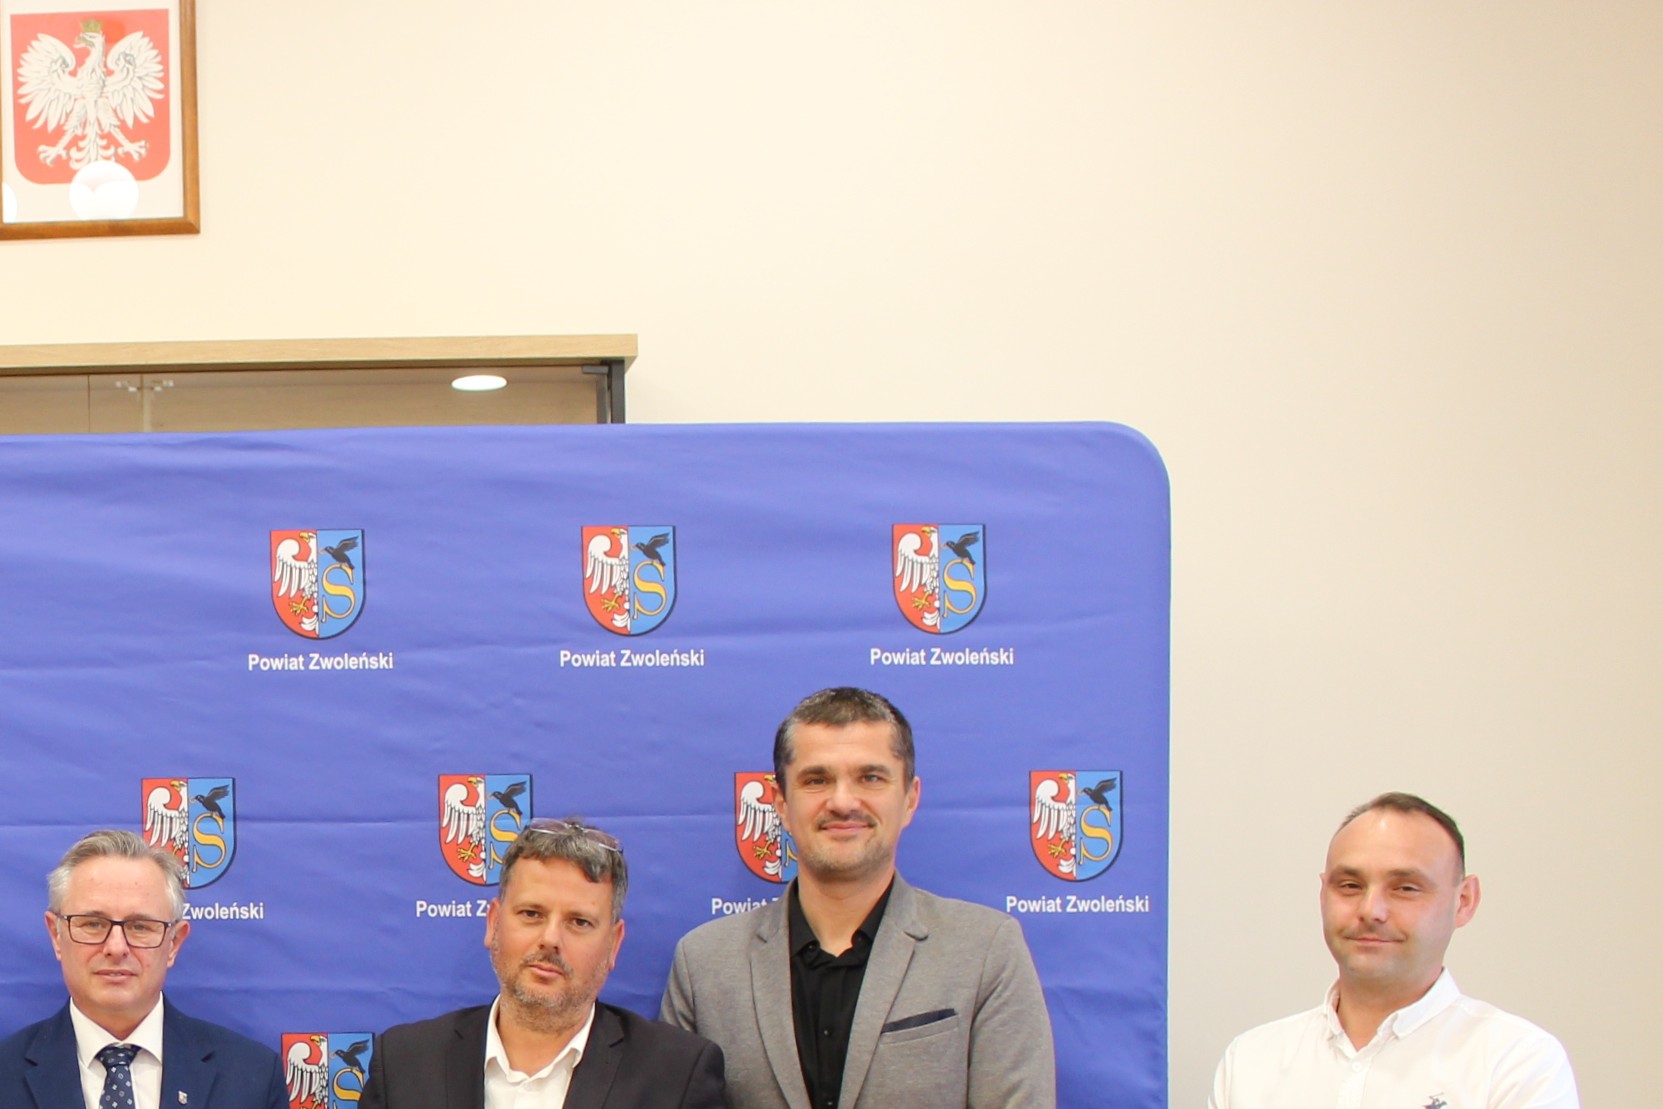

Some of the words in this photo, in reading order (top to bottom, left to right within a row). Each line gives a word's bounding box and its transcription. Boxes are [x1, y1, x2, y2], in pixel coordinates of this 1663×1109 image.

[248, 653, 305, 671] Powiat
[308, 652, 394, 670] Zwoleński
[560, 649, 617, 667] Powiat
[620, 649, 705, 667] Zwoleński
[870, 647, 927, 665] Powiat
[930, 647, 1014, 665] Zwoleński
[182, 902, 264, 920] Zwoleński
[416, 900, 472, 918] Powiat
[1006, 895, 1063, 914] Powiat
[1066, 894, 1149, 913] Zwoleński
